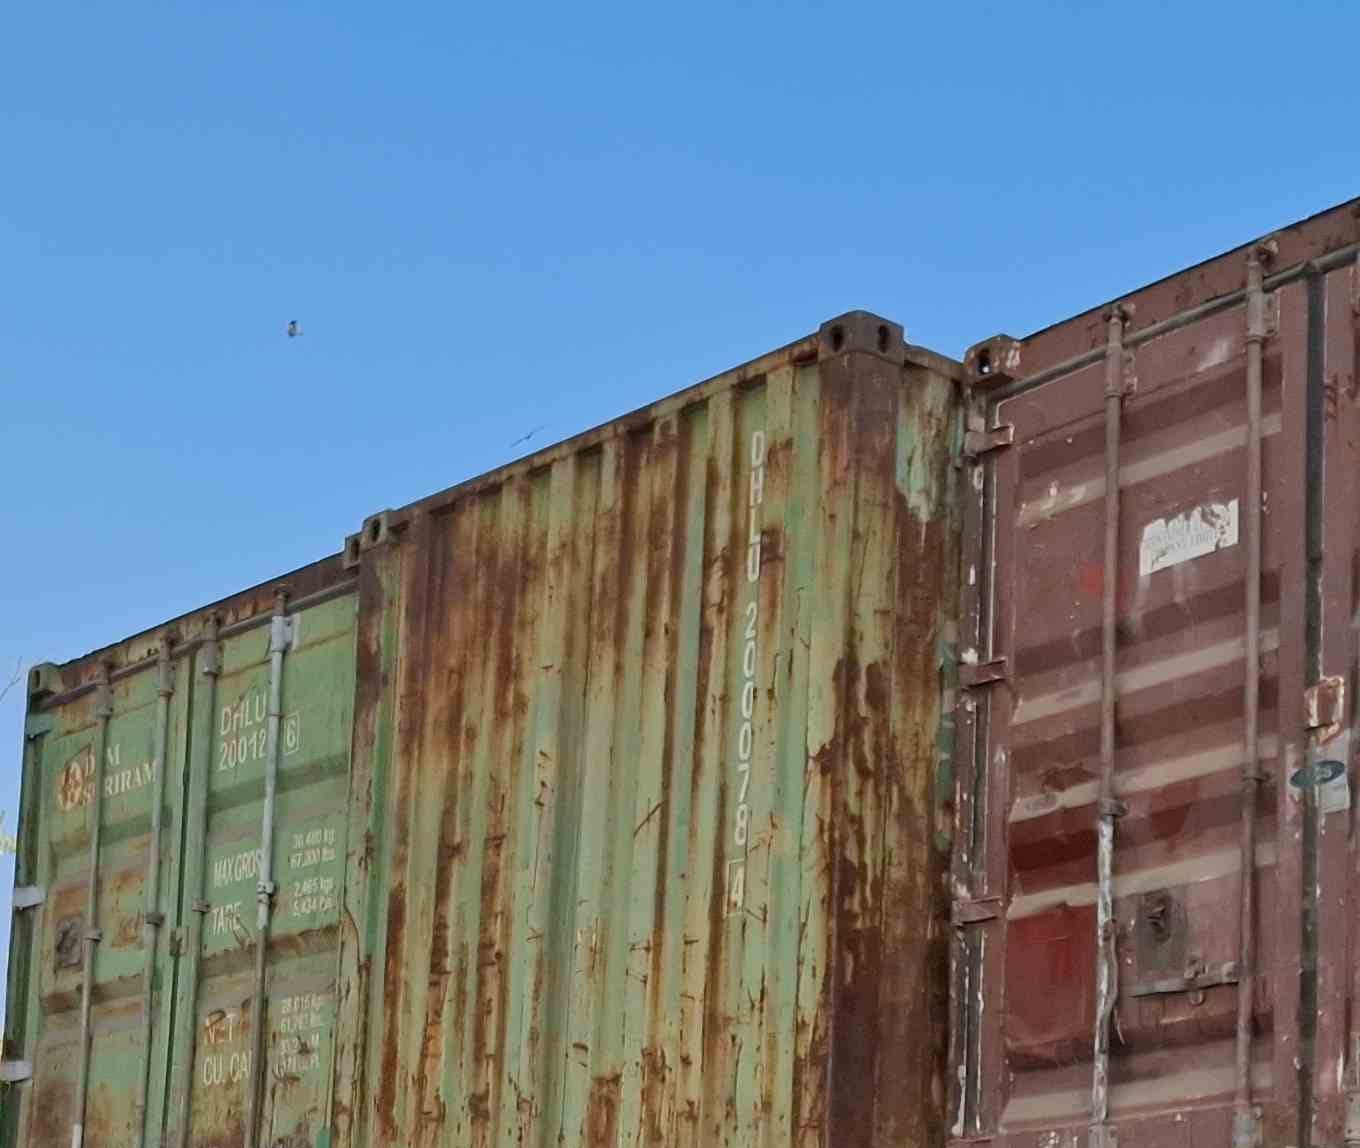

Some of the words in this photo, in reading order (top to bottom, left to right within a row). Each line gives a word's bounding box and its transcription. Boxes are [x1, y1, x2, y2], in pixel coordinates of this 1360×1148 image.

[748, 430, 767, 583] DHLU
[219, 728, 267, 771] 20012
[220, 689, 267, 736] DHLU
[734, 602, 758, 847] 200078
